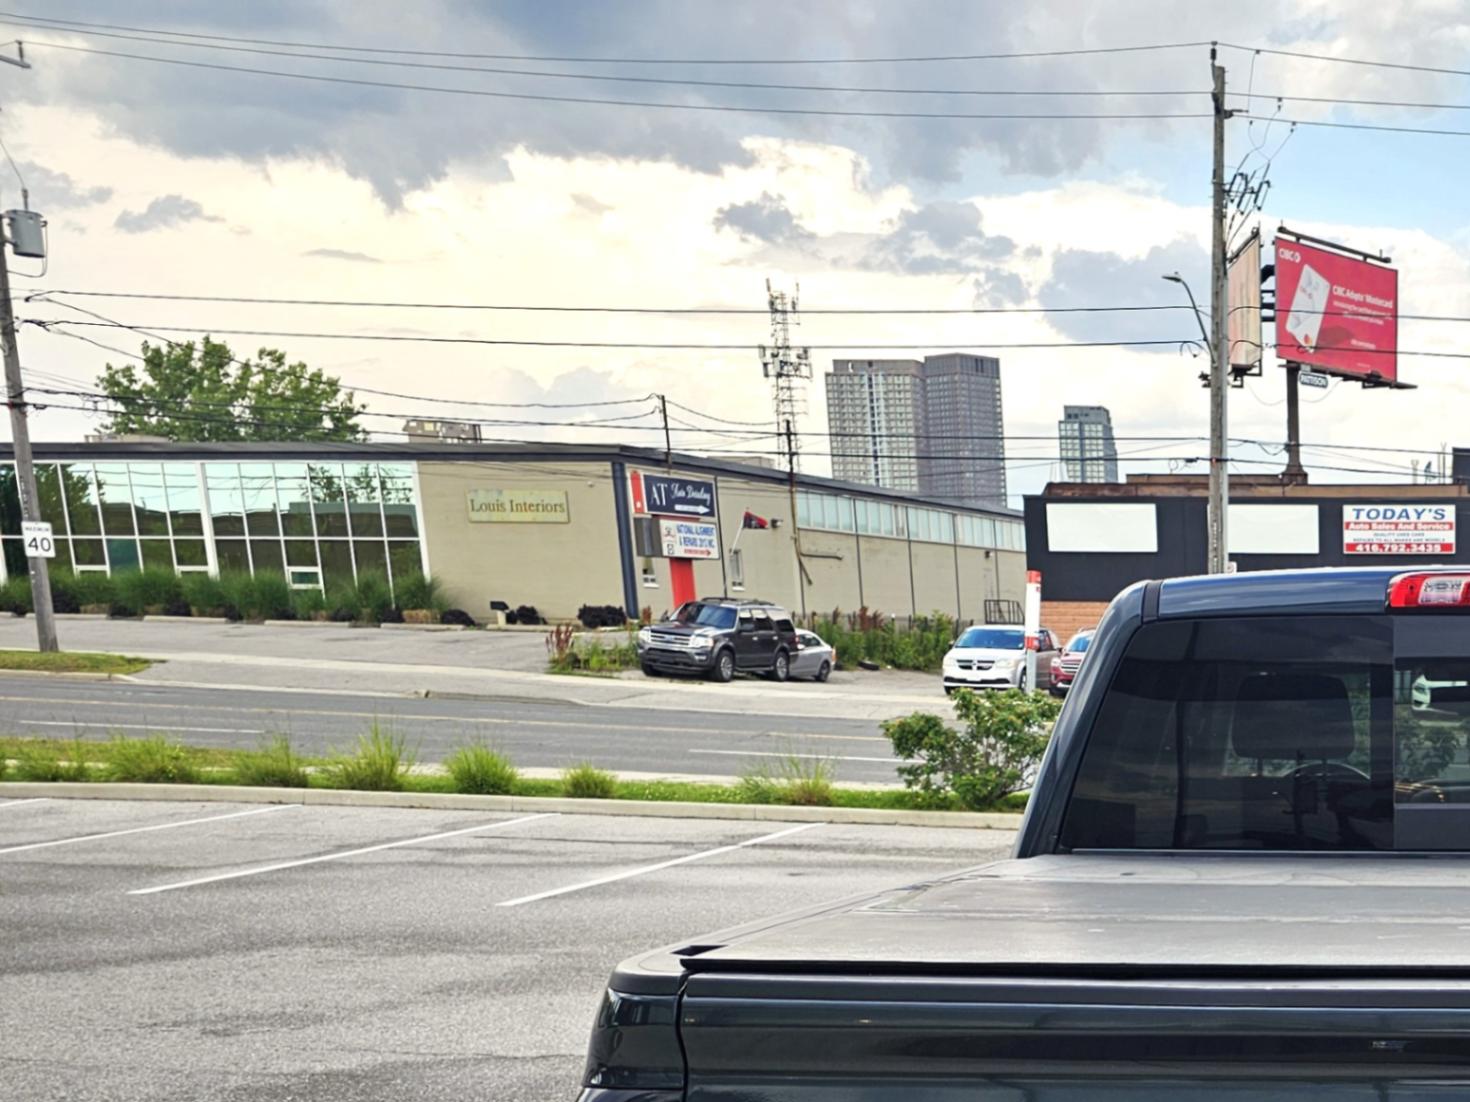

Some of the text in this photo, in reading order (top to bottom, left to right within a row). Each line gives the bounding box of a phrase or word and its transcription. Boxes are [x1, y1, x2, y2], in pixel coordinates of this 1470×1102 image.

[651, 483, 668, 506] AT
[470, 499, 565, 513] Louis Interiors
[1352, 508, 1446, 520] TODAY'S
[28, 537, 51, 552] 40
